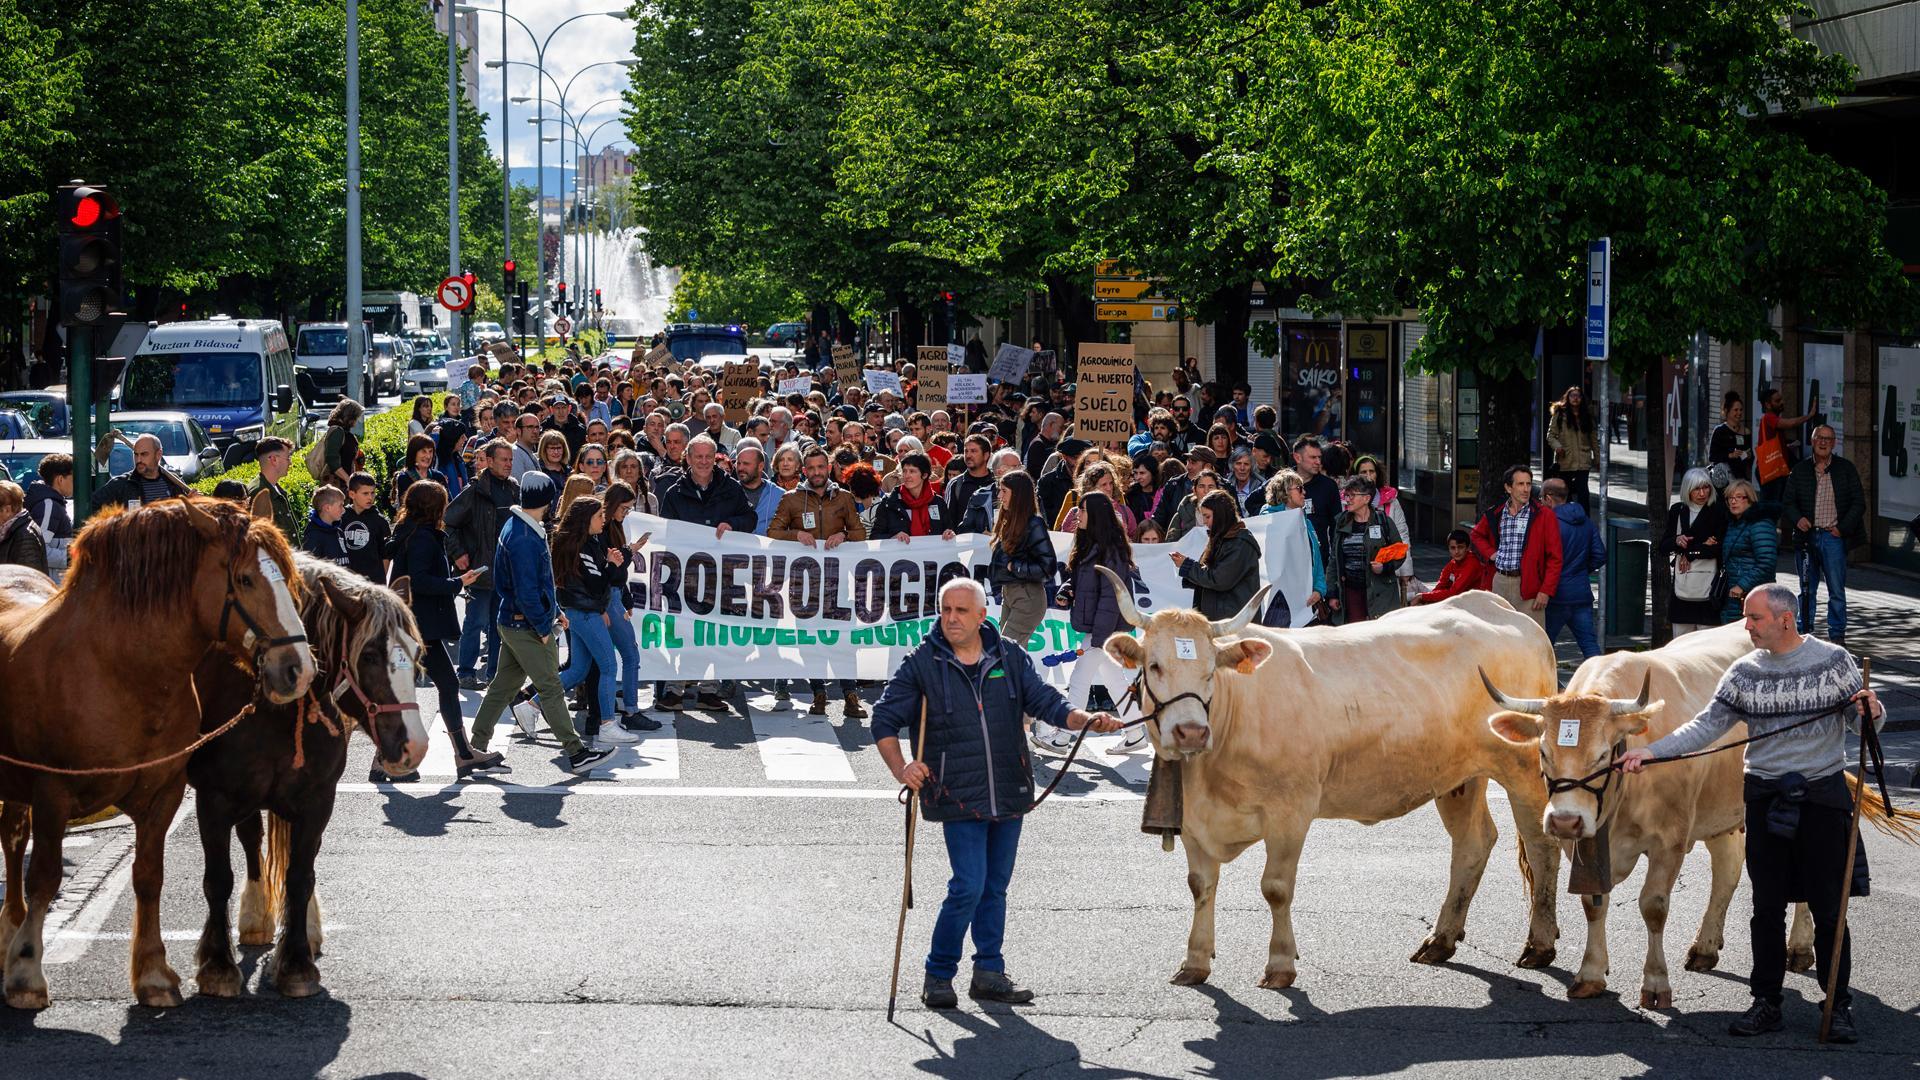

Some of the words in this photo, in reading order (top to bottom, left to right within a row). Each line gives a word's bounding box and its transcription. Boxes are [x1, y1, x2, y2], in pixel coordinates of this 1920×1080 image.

[1097, 285, 1121, 295] Leyre
[1097, 308, 1128, 318] Europa
[151, 342, 191, 352] Baztan
[193, 339, 240, 350] Bidasoa
[920, 350, 948, 361] AGRO
[783, 378, 800, 388] STOP
[839, 373, 857, 384] VIVO
[1081, 372, 1094, 383] AL
[919, 380, 941, 388] VACA
[1079, 396, 1127, 412] SUELO
[1080, 418, 1129, 433] MUERTO
[641, 613, 684, 650] AL
